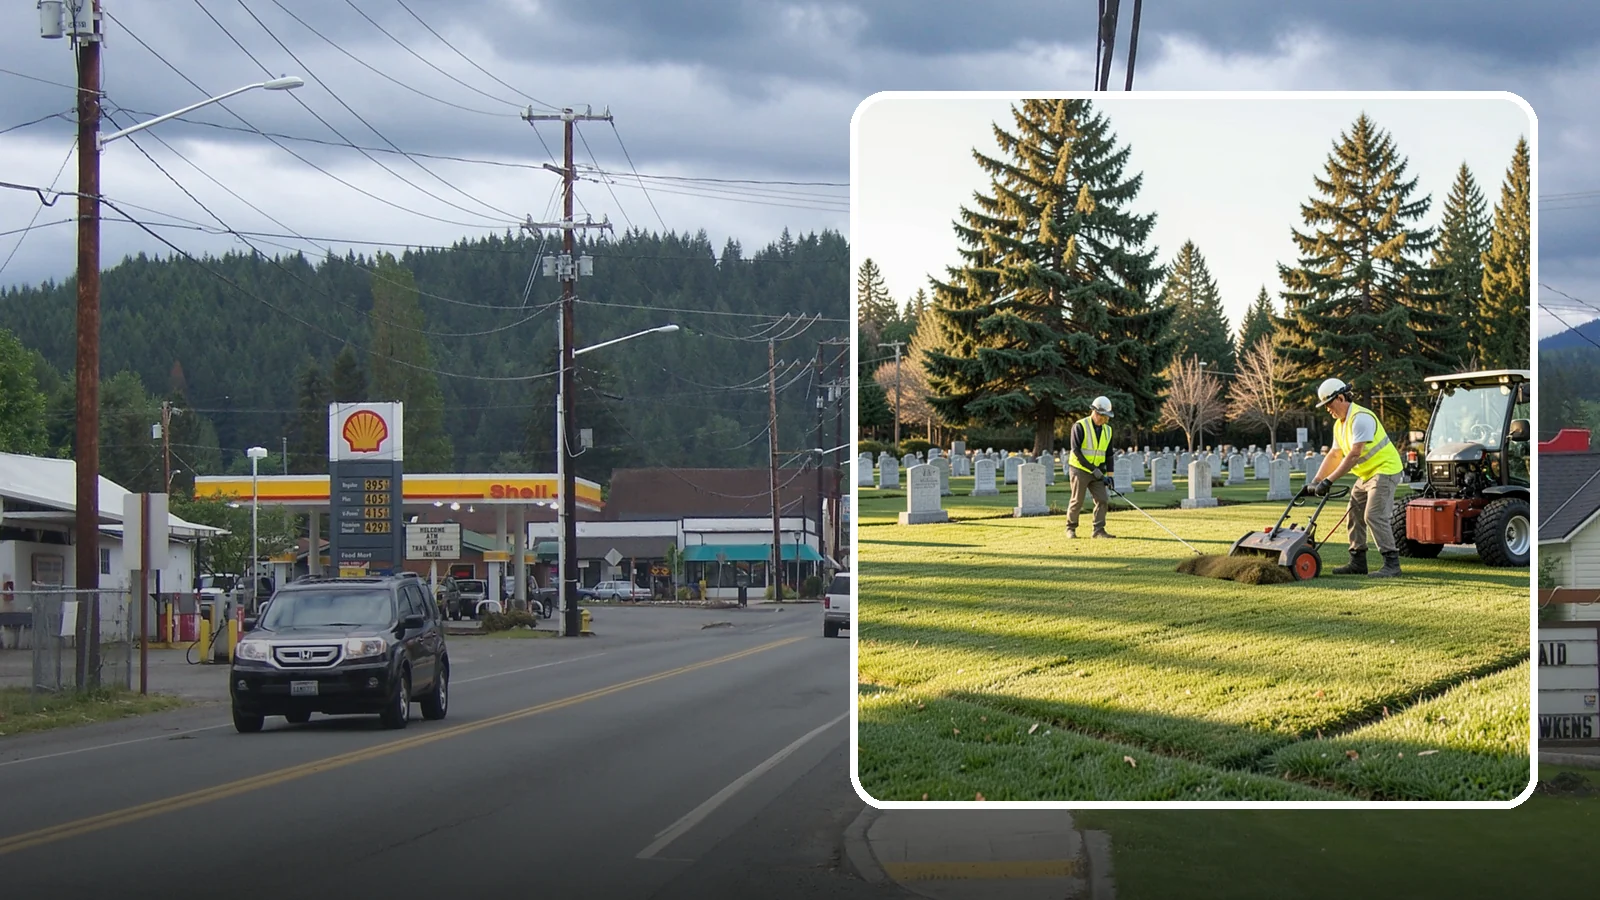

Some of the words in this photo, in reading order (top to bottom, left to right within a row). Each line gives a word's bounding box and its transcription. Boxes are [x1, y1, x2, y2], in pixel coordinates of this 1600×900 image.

[490, 484, 547, 499] Shell
[365, 494, 383, 504] 405
[365, 508, 383, 518] 415
[365, 522, 383, 533] 429
[1539, 642, 1566, 665] AID
[1539, 716, 1592, 739] WKENS
